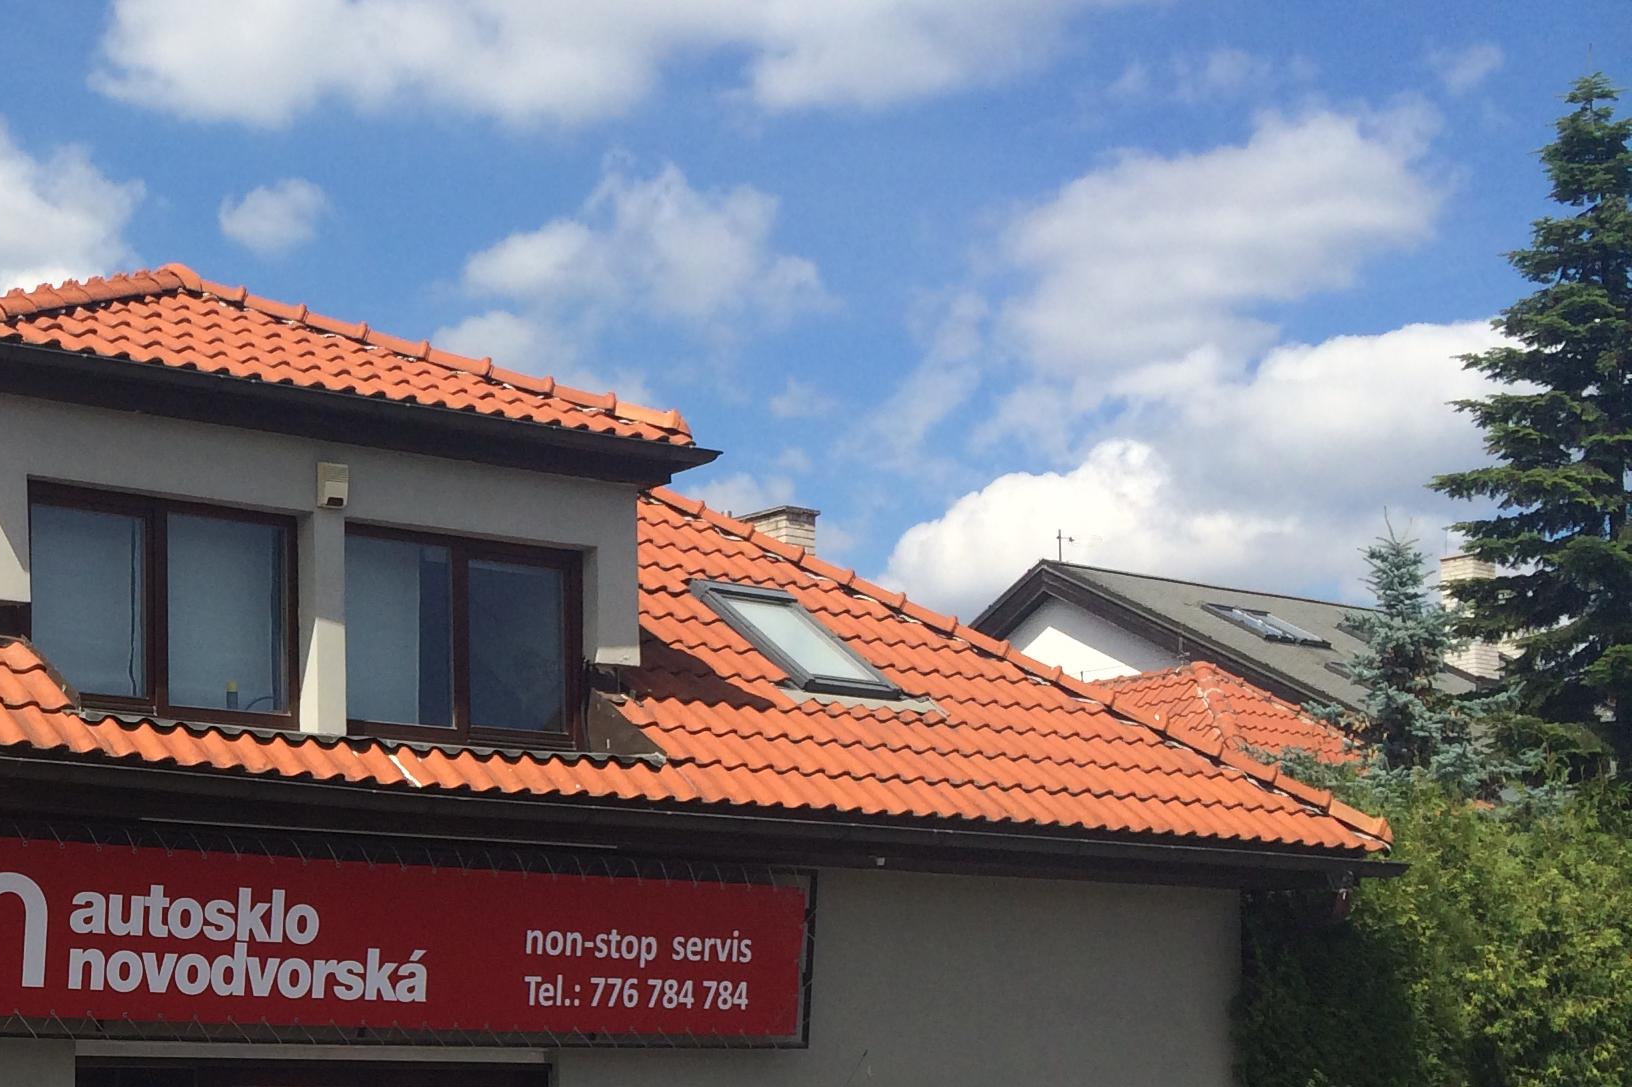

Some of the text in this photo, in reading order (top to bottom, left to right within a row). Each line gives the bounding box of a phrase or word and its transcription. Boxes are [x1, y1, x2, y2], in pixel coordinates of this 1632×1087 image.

[70, 887, 318, 944] autosklo
[526, 928, 752, 968] non-stop servis
[68, 942, 427, 1003] novodvorská
[525, 974, 748, 1012] Tel.: 776 784 784
